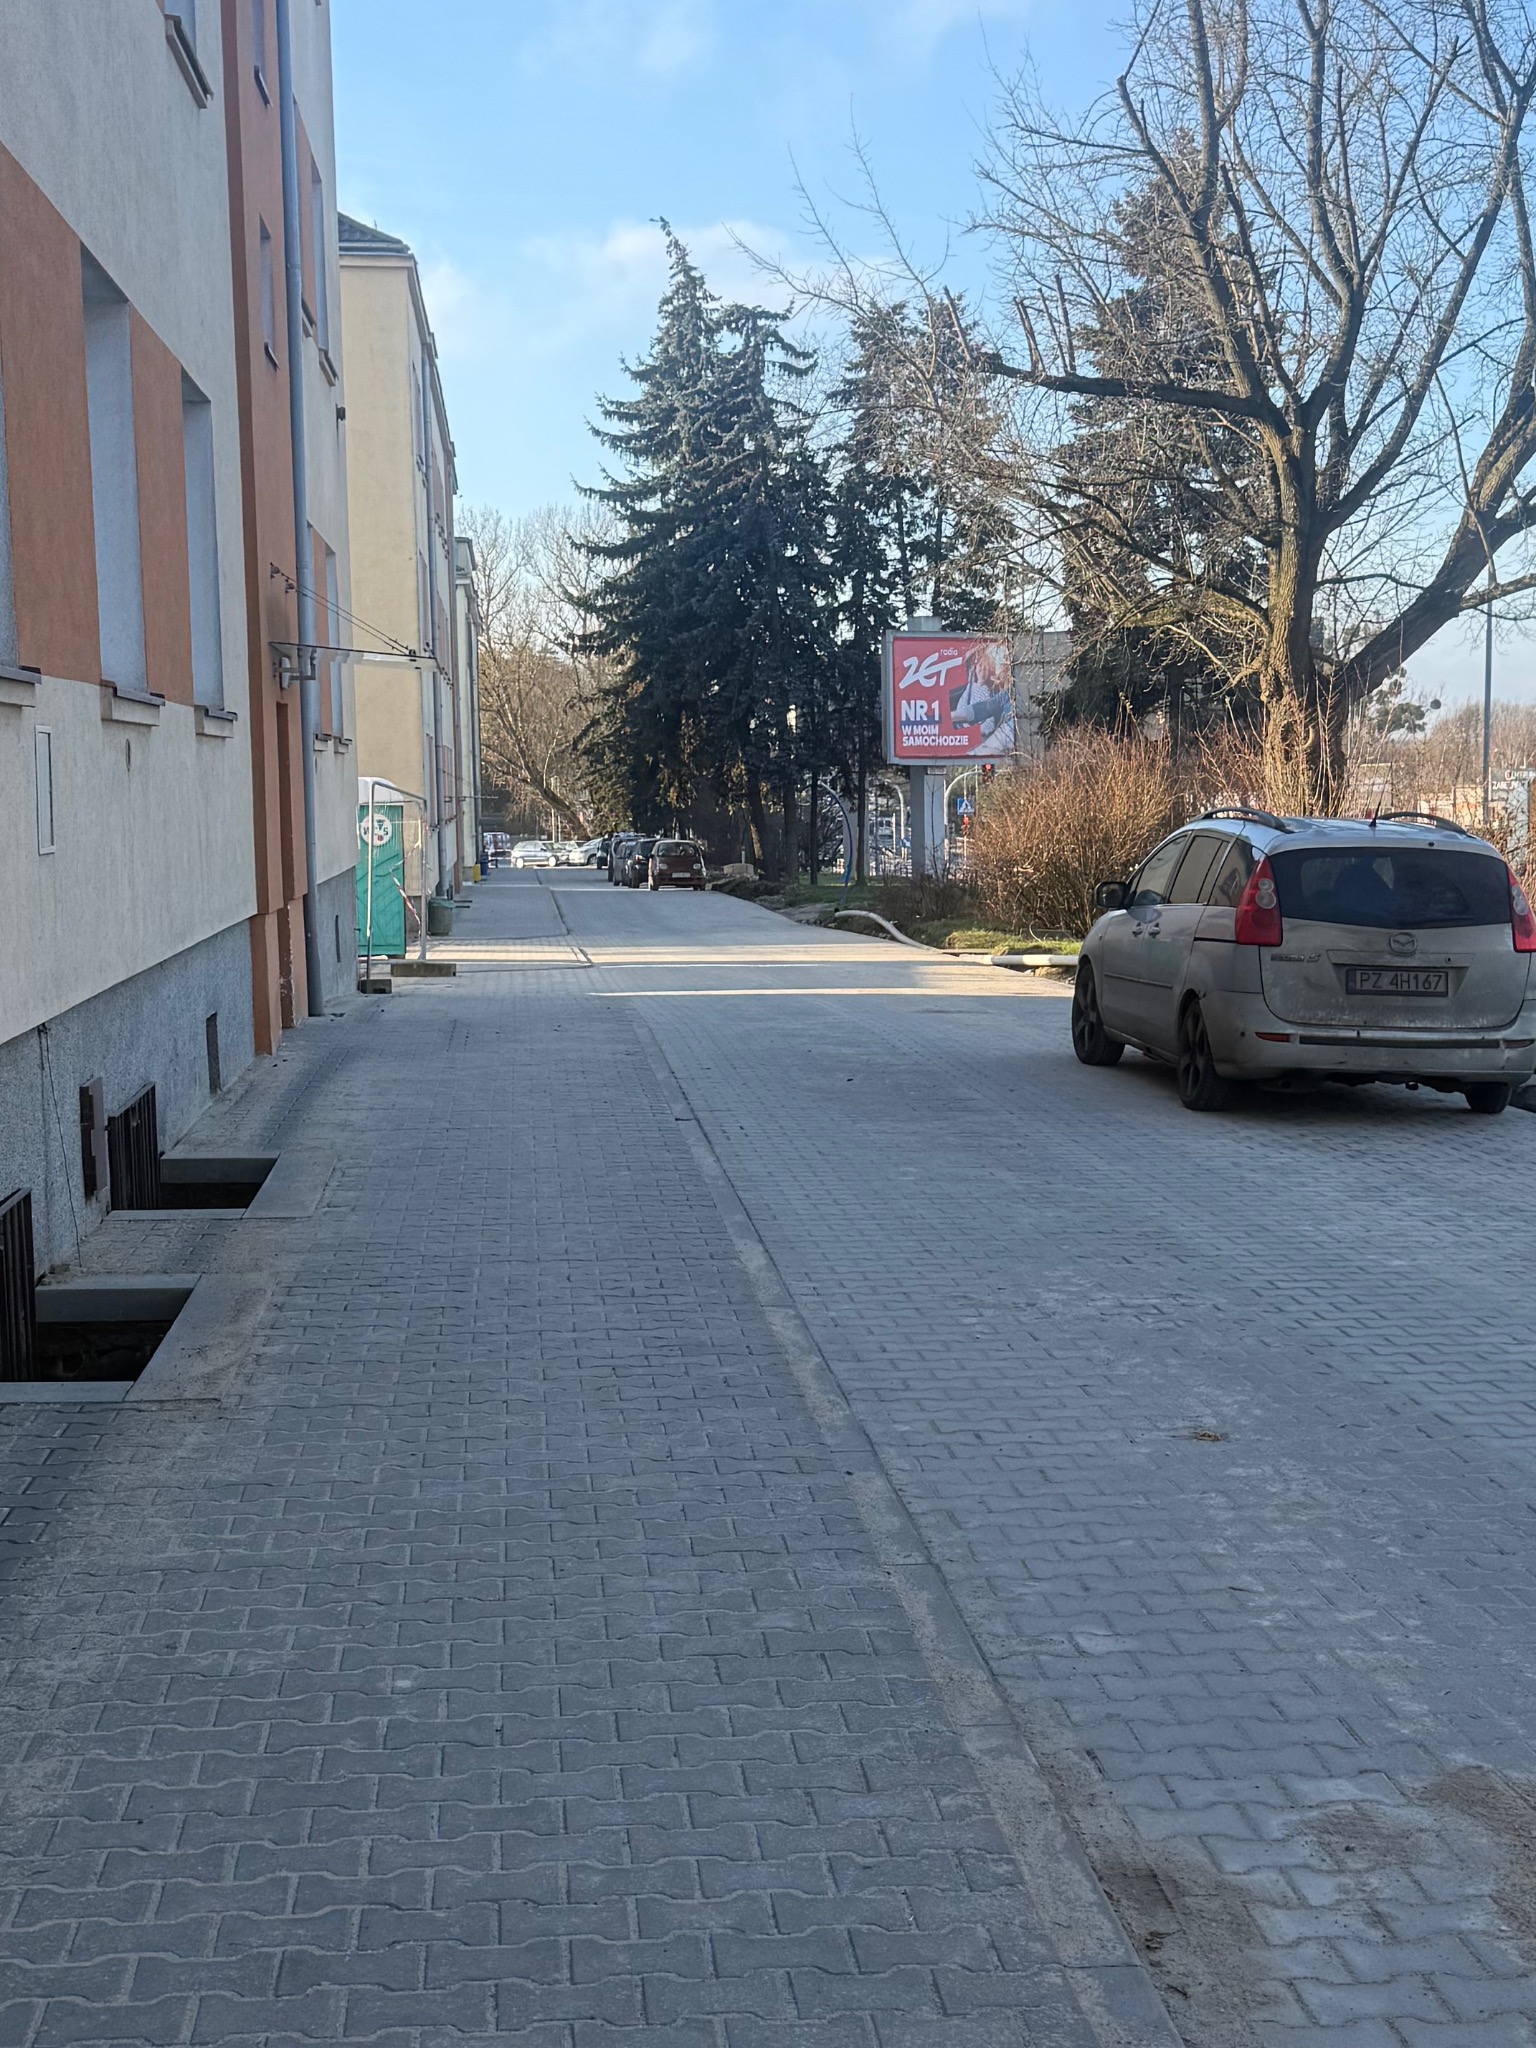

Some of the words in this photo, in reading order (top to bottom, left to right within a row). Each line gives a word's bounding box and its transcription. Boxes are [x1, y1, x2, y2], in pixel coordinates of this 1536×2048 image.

[940, 648, 958, 656] radio
[901, 700, 928, 721] NR
[932, 699, 939, 721] 1
[902, 725, 912, 735] W
[914, 725, 938, 735] MOIM
[902, 735, 969, 746] SAMOCHODZIE
[1359, 972, 1383, 989] PZ
[1389, 974, 1442, 990] 4H167
